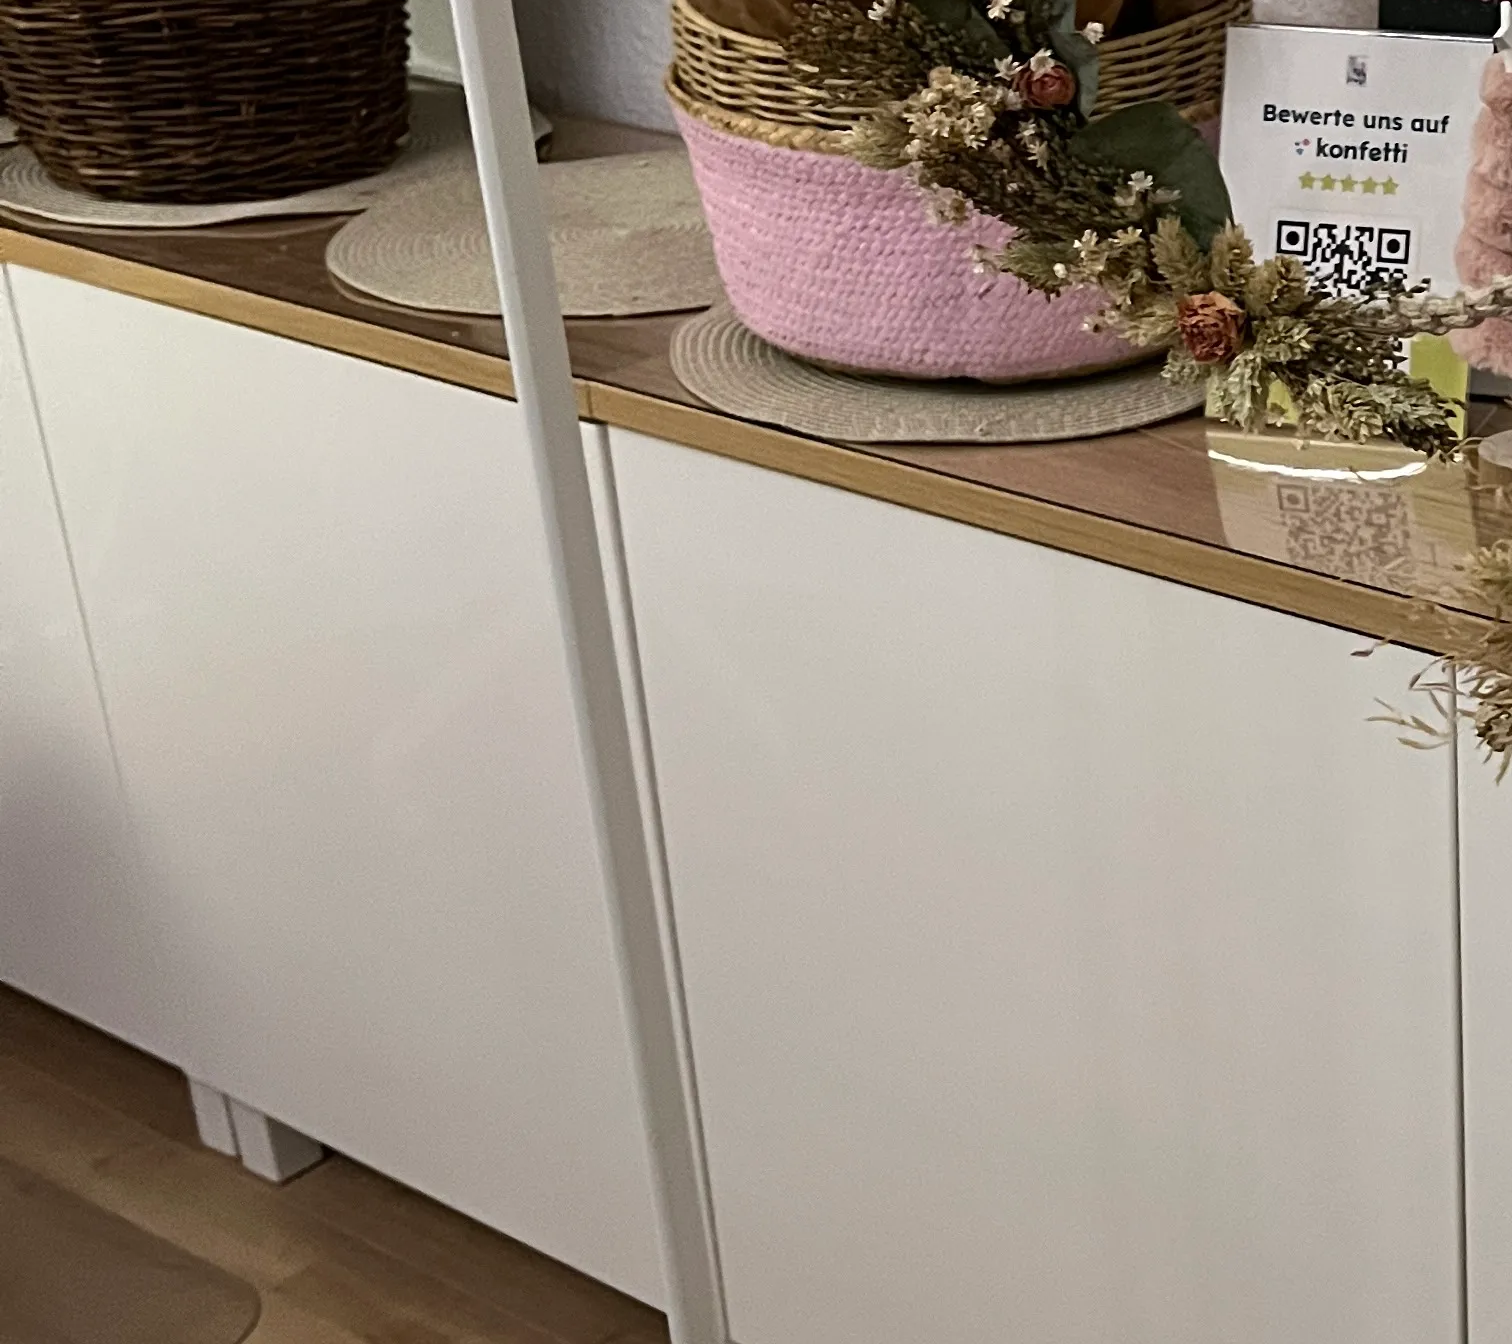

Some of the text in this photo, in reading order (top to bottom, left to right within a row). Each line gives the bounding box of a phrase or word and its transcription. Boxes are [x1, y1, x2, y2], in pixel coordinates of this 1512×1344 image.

[1262, 103, 1450, 134] Bewerte uns auf
[1315, 137, 1409, 163] konfetti
